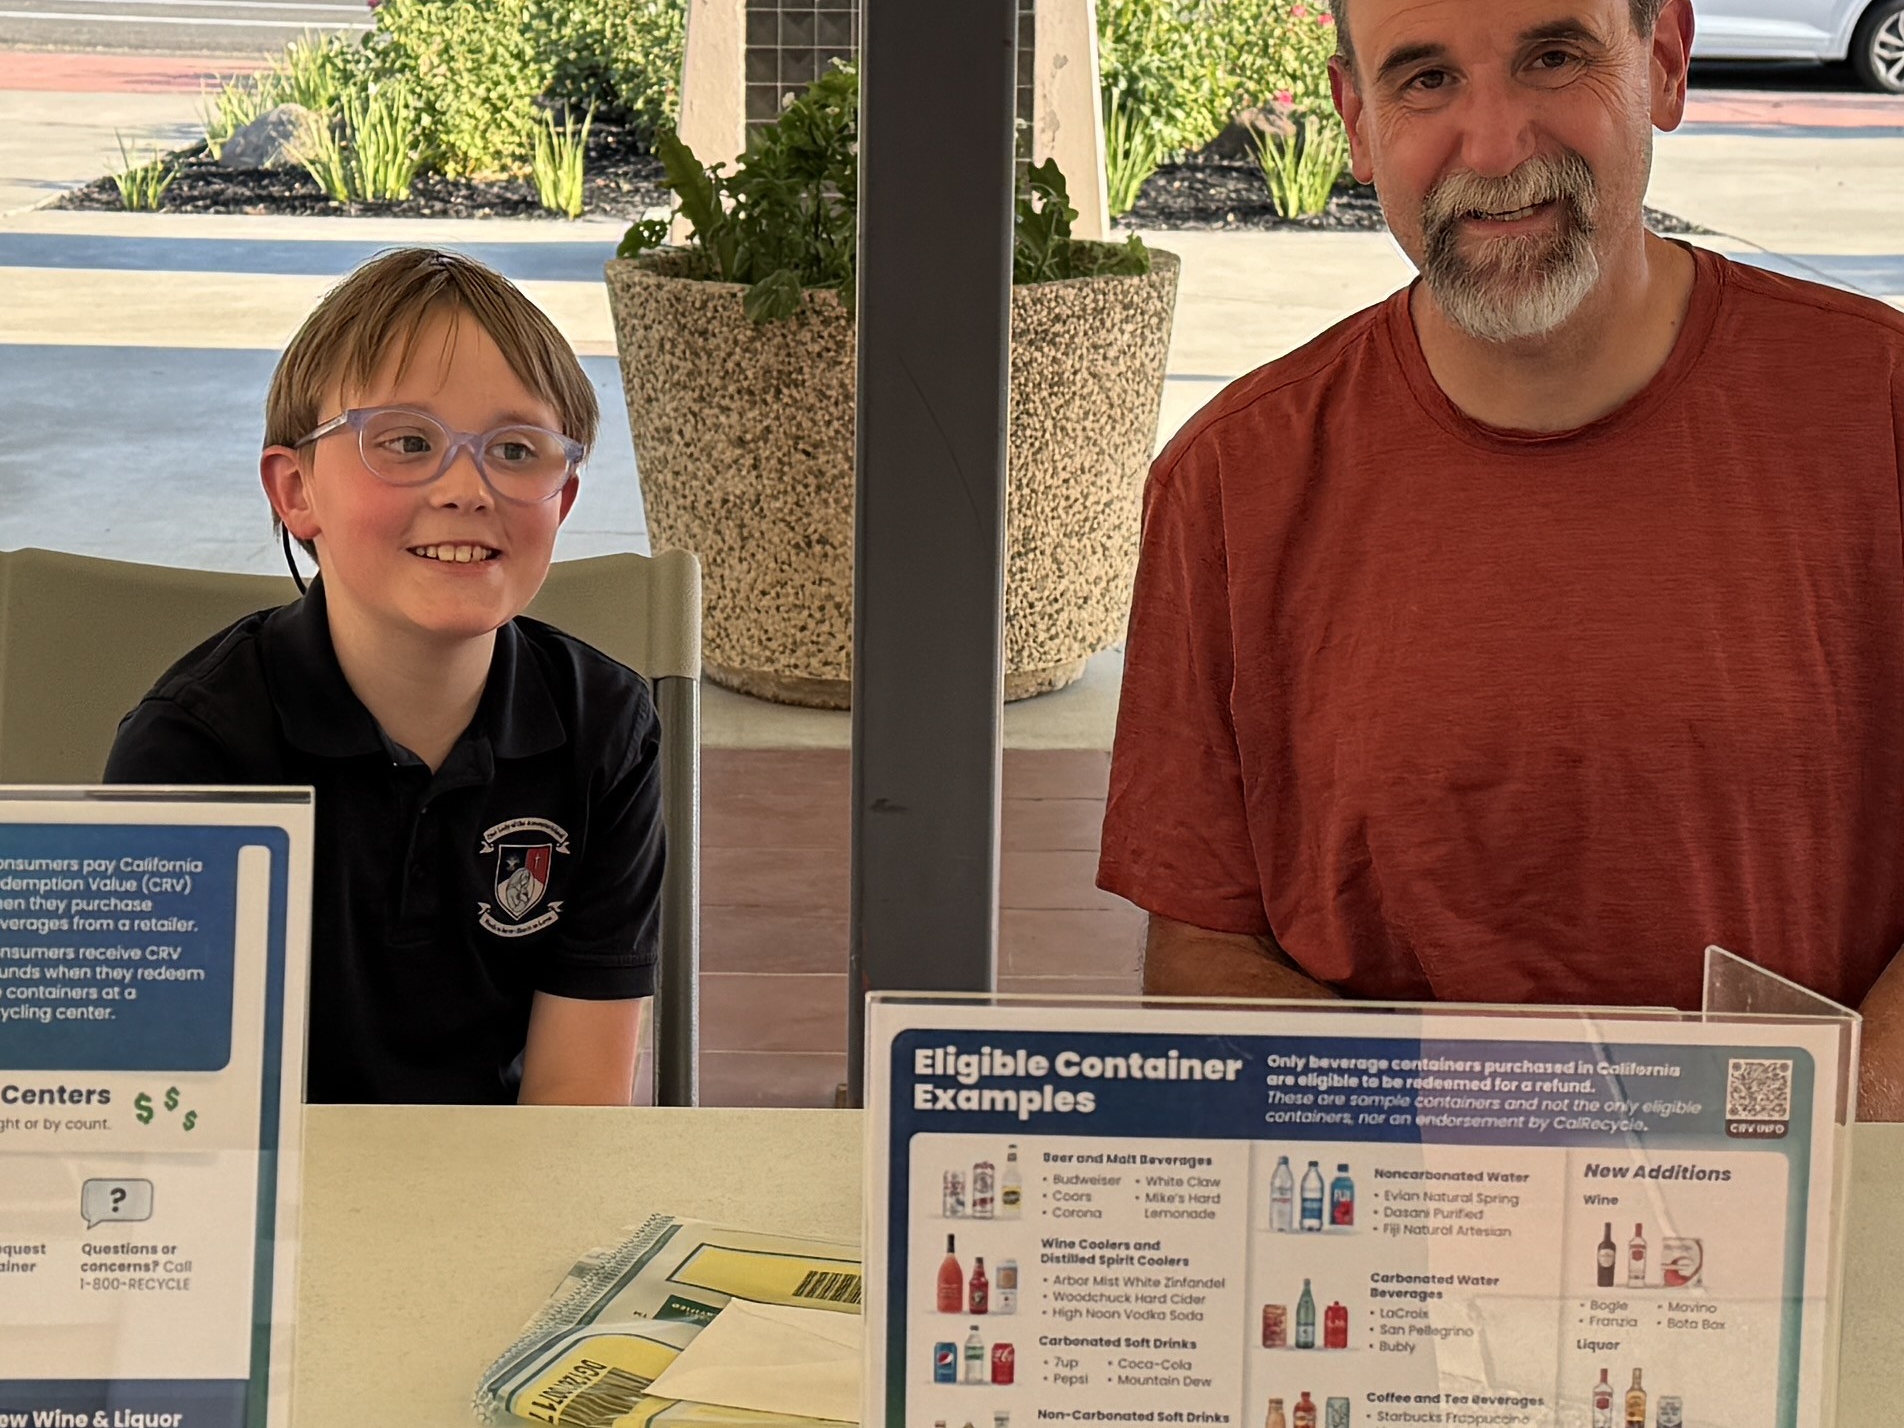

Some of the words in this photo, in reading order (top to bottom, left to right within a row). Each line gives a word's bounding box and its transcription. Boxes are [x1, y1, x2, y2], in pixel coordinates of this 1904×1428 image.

[82, 859, 116, 875] pay
[119, 856, 202, 872] California
[88, 876, 137, 891] Value
[141, 874, 191, 895] (CRV)
[914, 1045, 1049, 1084] Eligible
[1054, 1049, 1242, 1080] Container
[1, 1084, 110, 1105] Centers
[914, 1083, 1095, 1120] Examples
[1374, 1168, 1483, 1181] Noncarbonated
[1486, 1172, 1529, 1182] Water
[1583, 1163, 1629, 1178] New
[1632, 1164, 1731, 1181] Additions
[1145, 1176, 1184, 1187] White
[1186, 1176, 1221, 1188] Claw
[81, 1242, 157, 1256] Questions
[161, 1245, 176, 1254] or
[1041, 1237, 1075, 1249] Wine
[1078, 1238, 1130, 1250] Coolers
[1133, 1240, 1160, 1250] and
[80, 1260, 159, 1272] concerns?
[163, 1260, 192, 1272] Call
[1040, 1253, 1095, 1264] Distilled
[1099, 1253, 1134, 1268] Spirit
[1137, 1255, 1189, 1266] Coolers
[80, 1277, 189, 1290] 1-800-RECYCLE
[1052, 1307, 1082, 1321] High
[1085, 1307, 1121, 1319] Noon
[1123, 1309, 1166, 1320] Vodka
[1169, 1309, 1203, 1321] Soda
[1038, 1335, 1121, 1347] Carbonated
[1124, 1337, 1150, 1348] Soft
[1153, 1337, 1196, 1349] Drinks
[1117, 1358, 1192, 1370] Coca-Cola
[1366, 1392, 1411, 1403] Coffee
[1413, 1393, 1441, 1404] and
[1444, 1393, 1469, 1404] Tea
[32, 1408, 88, 1428] Wine
[92, 1410, 109, 1428] &
